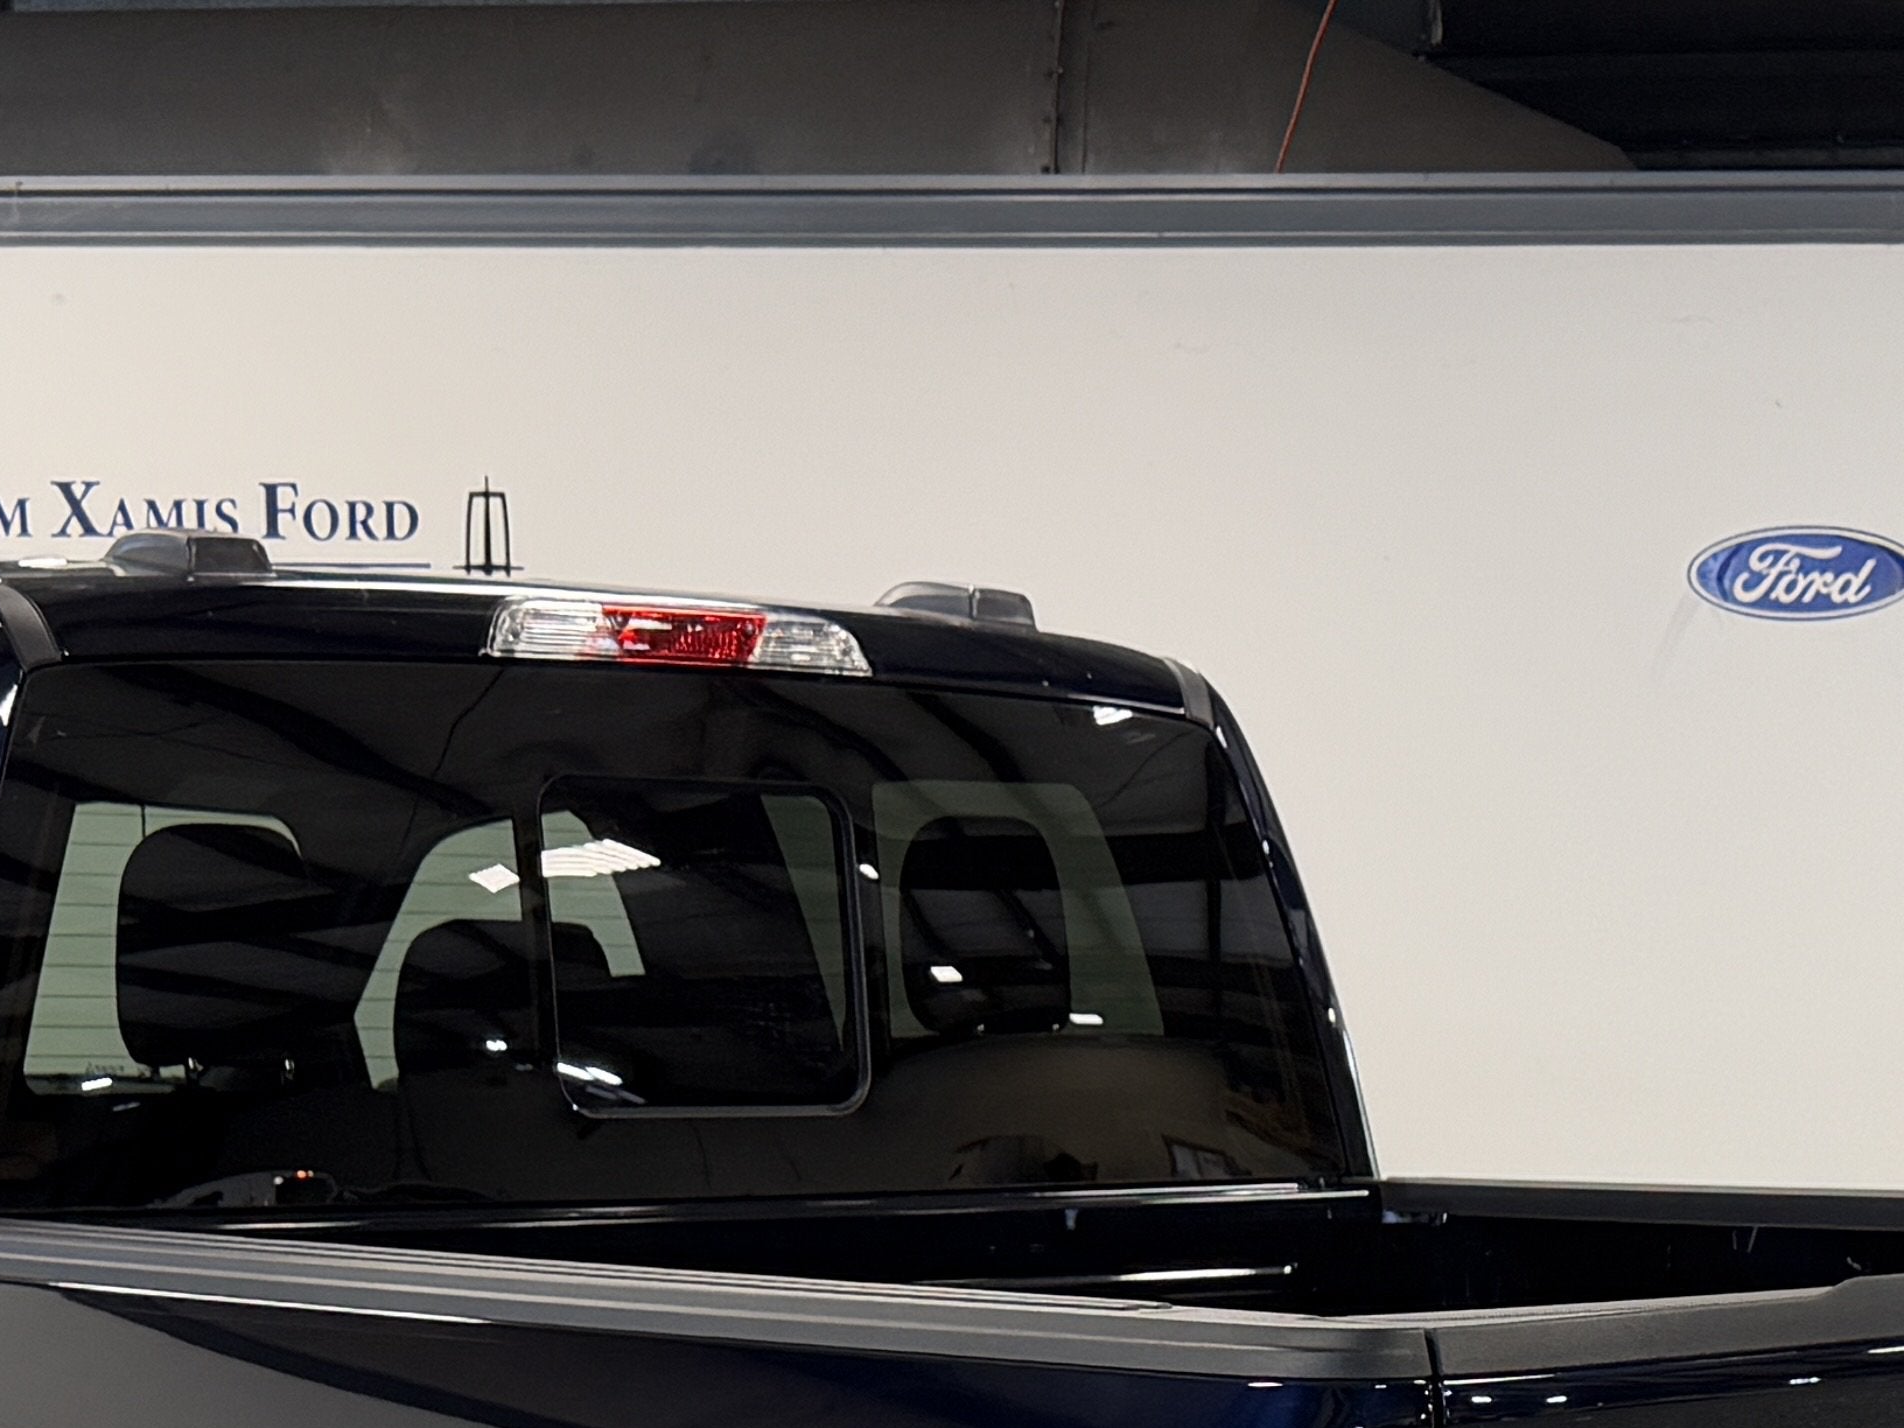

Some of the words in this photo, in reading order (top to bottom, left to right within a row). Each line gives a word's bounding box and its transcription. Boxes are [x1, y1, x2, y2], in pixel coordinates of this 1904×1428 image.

[50, 480, 239, 538] XAMIS
[259, 482, 420, 542] FORD
[1732, 541, 1873, 604] Ford
